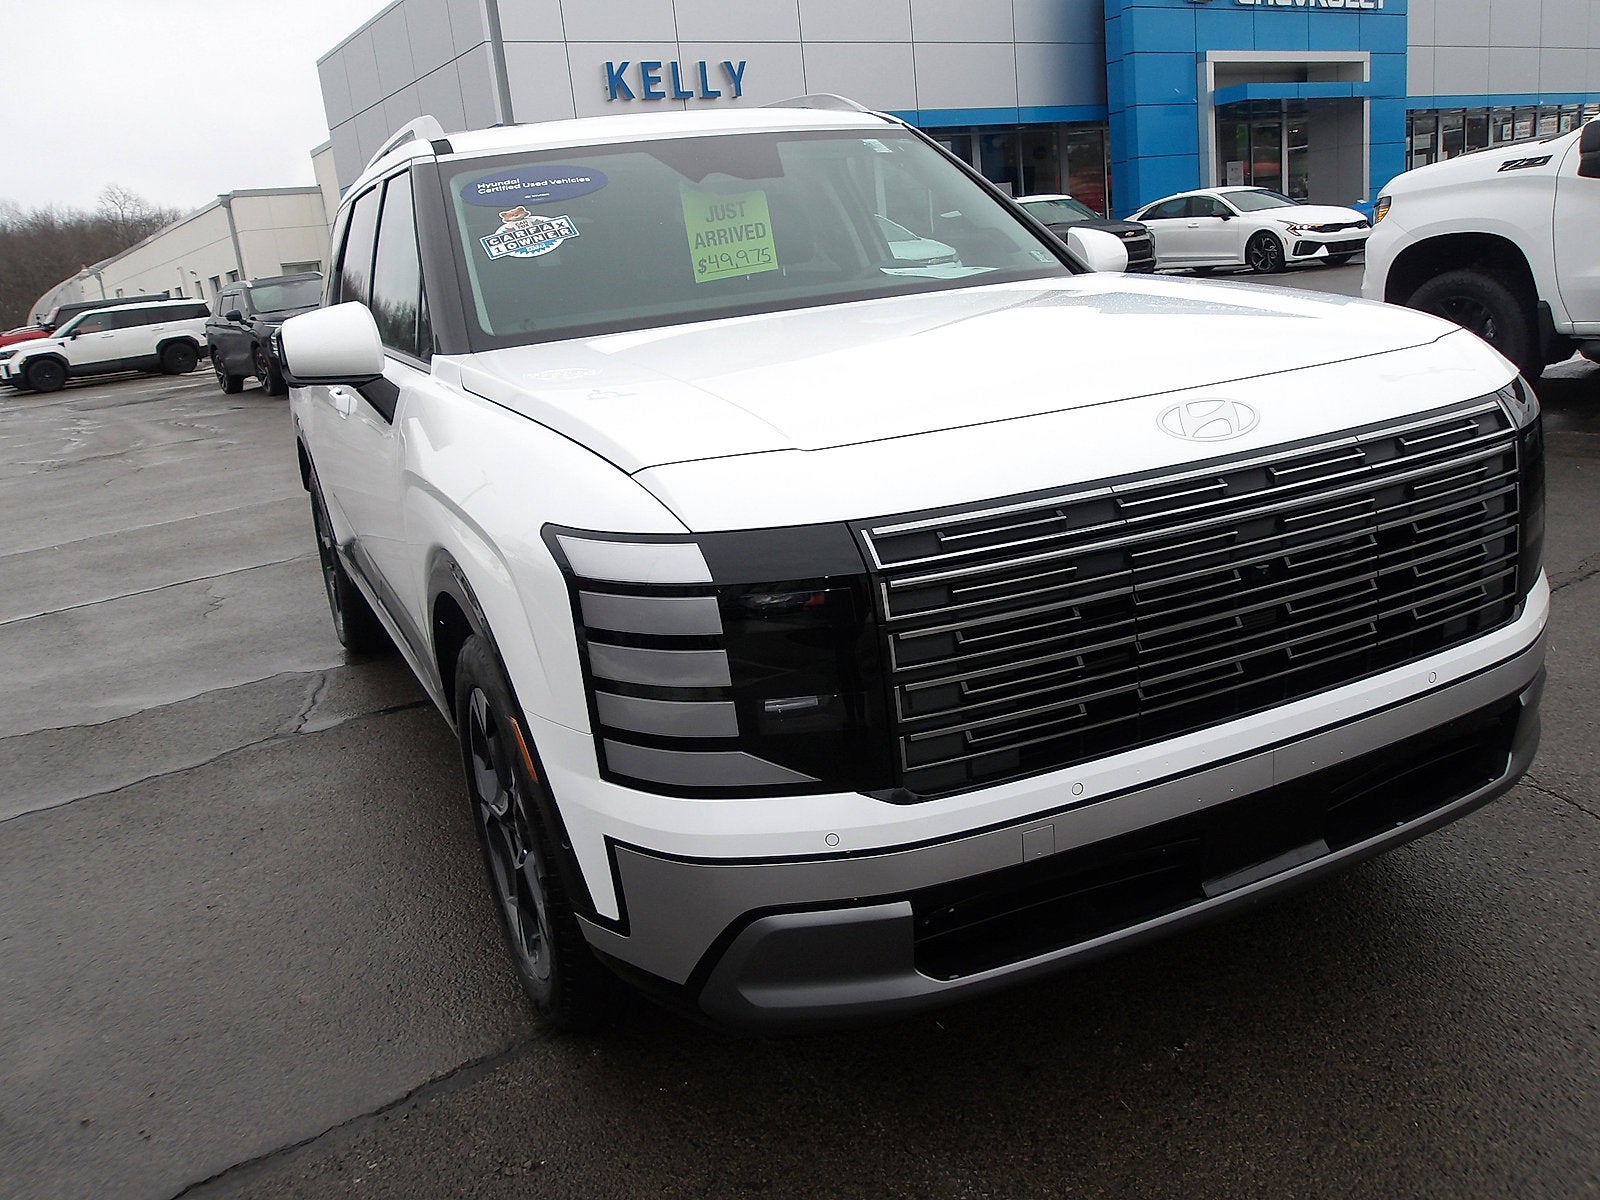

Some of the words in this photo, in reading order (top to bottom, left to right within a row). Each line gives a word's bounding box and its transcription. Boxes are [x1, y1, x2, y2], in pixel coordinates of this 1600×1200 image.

[604, 60, 747, 100] KELLY
[477, 178, 520, 189] Hyundai
[477, 184, 521, 195] Certified
[522, 179, 548, 188] Used
[549, 176, 591, 186] Vehicles
[705, 200, 747, 223] JUST
[486, 220, 566, 247] CARFAX
[494, 244, 504, 253] 1
[504, 226, 573, 250] OWNER
[694, 222, 767, 249] ARRIVED
[697, 247, 772, 275] $49,975
